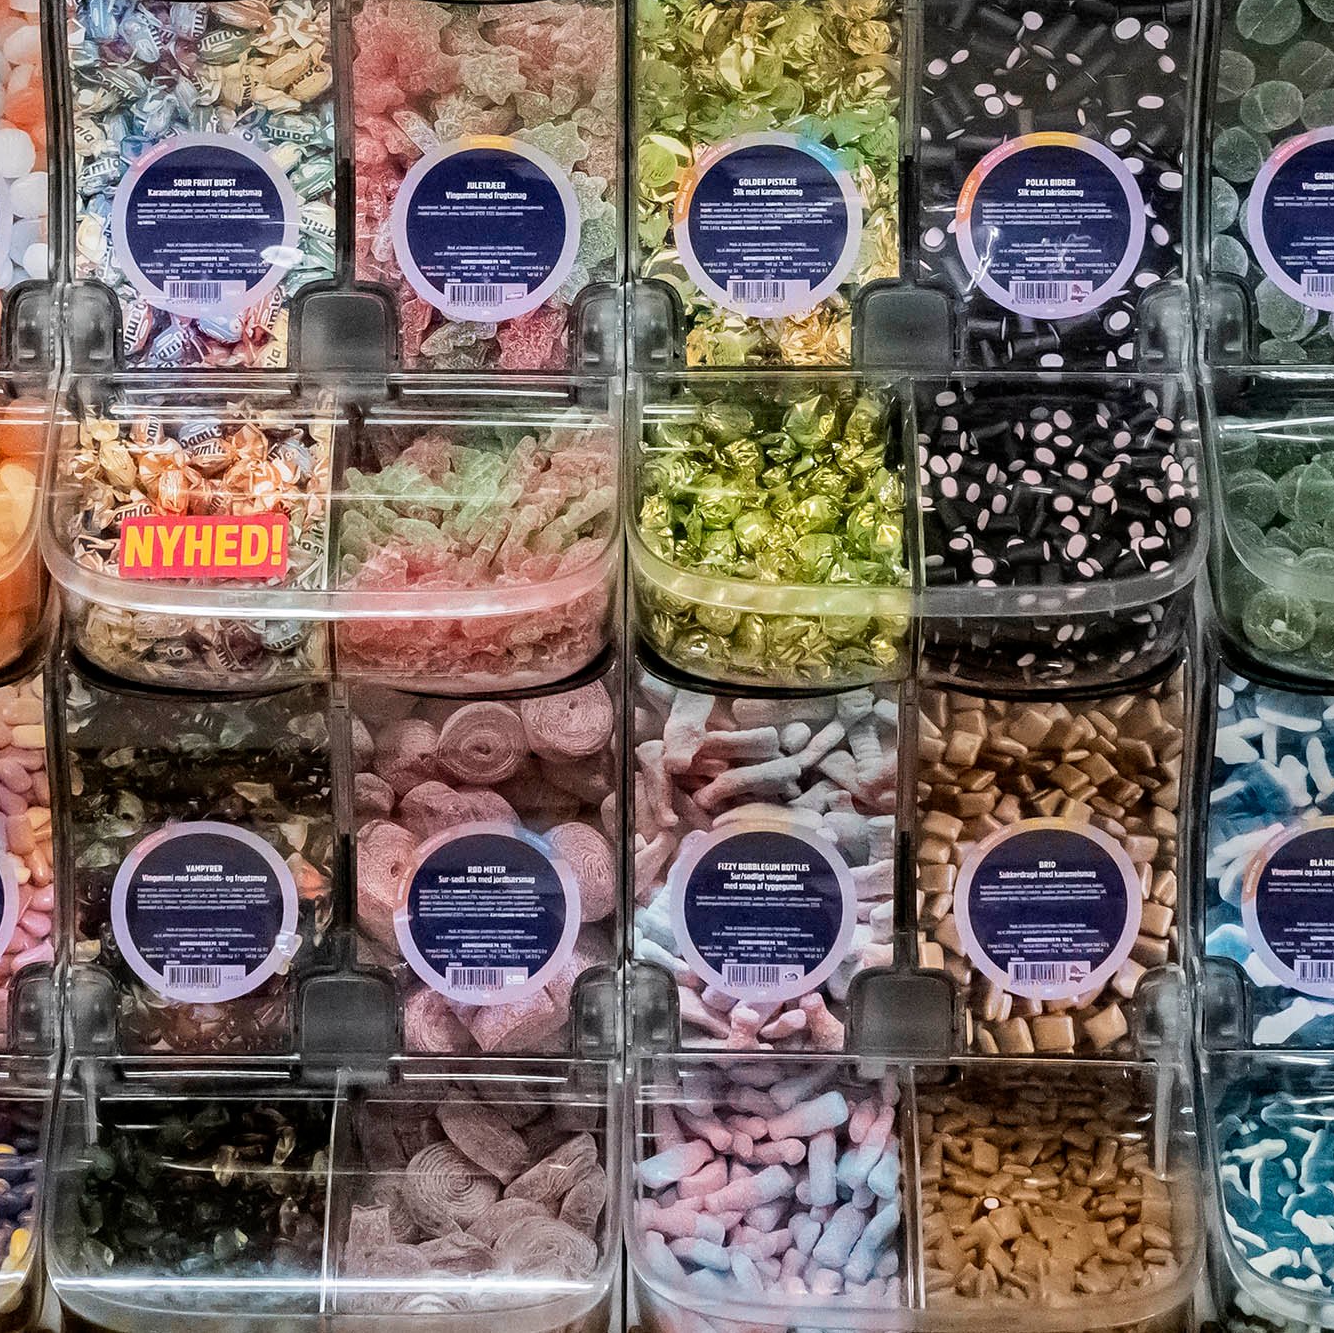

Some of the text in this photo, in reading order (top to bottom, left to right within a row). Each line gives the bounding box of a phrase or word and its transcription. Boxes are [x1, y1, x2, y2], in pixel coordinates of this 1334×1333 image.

[174, 179, 235, 187] SOUR FRUIT BURST
[467, 181, 505, 190] JULETRÆER
[739, 178, 797, 187] GOLDEN PISTACIE
[1026, 178, 1075, 187] POLKA BIDDER
[733, 188, 803, 197] Slik med karamelsmag
[1018, 188, 1083, 197] Slik med lakridssmag
[124, 524, 283, 567] NYHED!
[186, 865, 223, 873] VAMPYRER
[718, 862, 809, 871] FIZZY BUBBLEGUM BOTTLES
[1039, 860, 1056, 869] BRIO
[468, 866, 505, 874] RØD METER
[467, 875, 477, 883] slik
[478, 875, 492, 883] med
[493, 875, 535, 884] jordbærsmag
[766, 872, 797, 882] vingummi
[724, 882, 737, 890] med
[739, 883, 756, 891] smag
[757, 882, 763, 890] af
